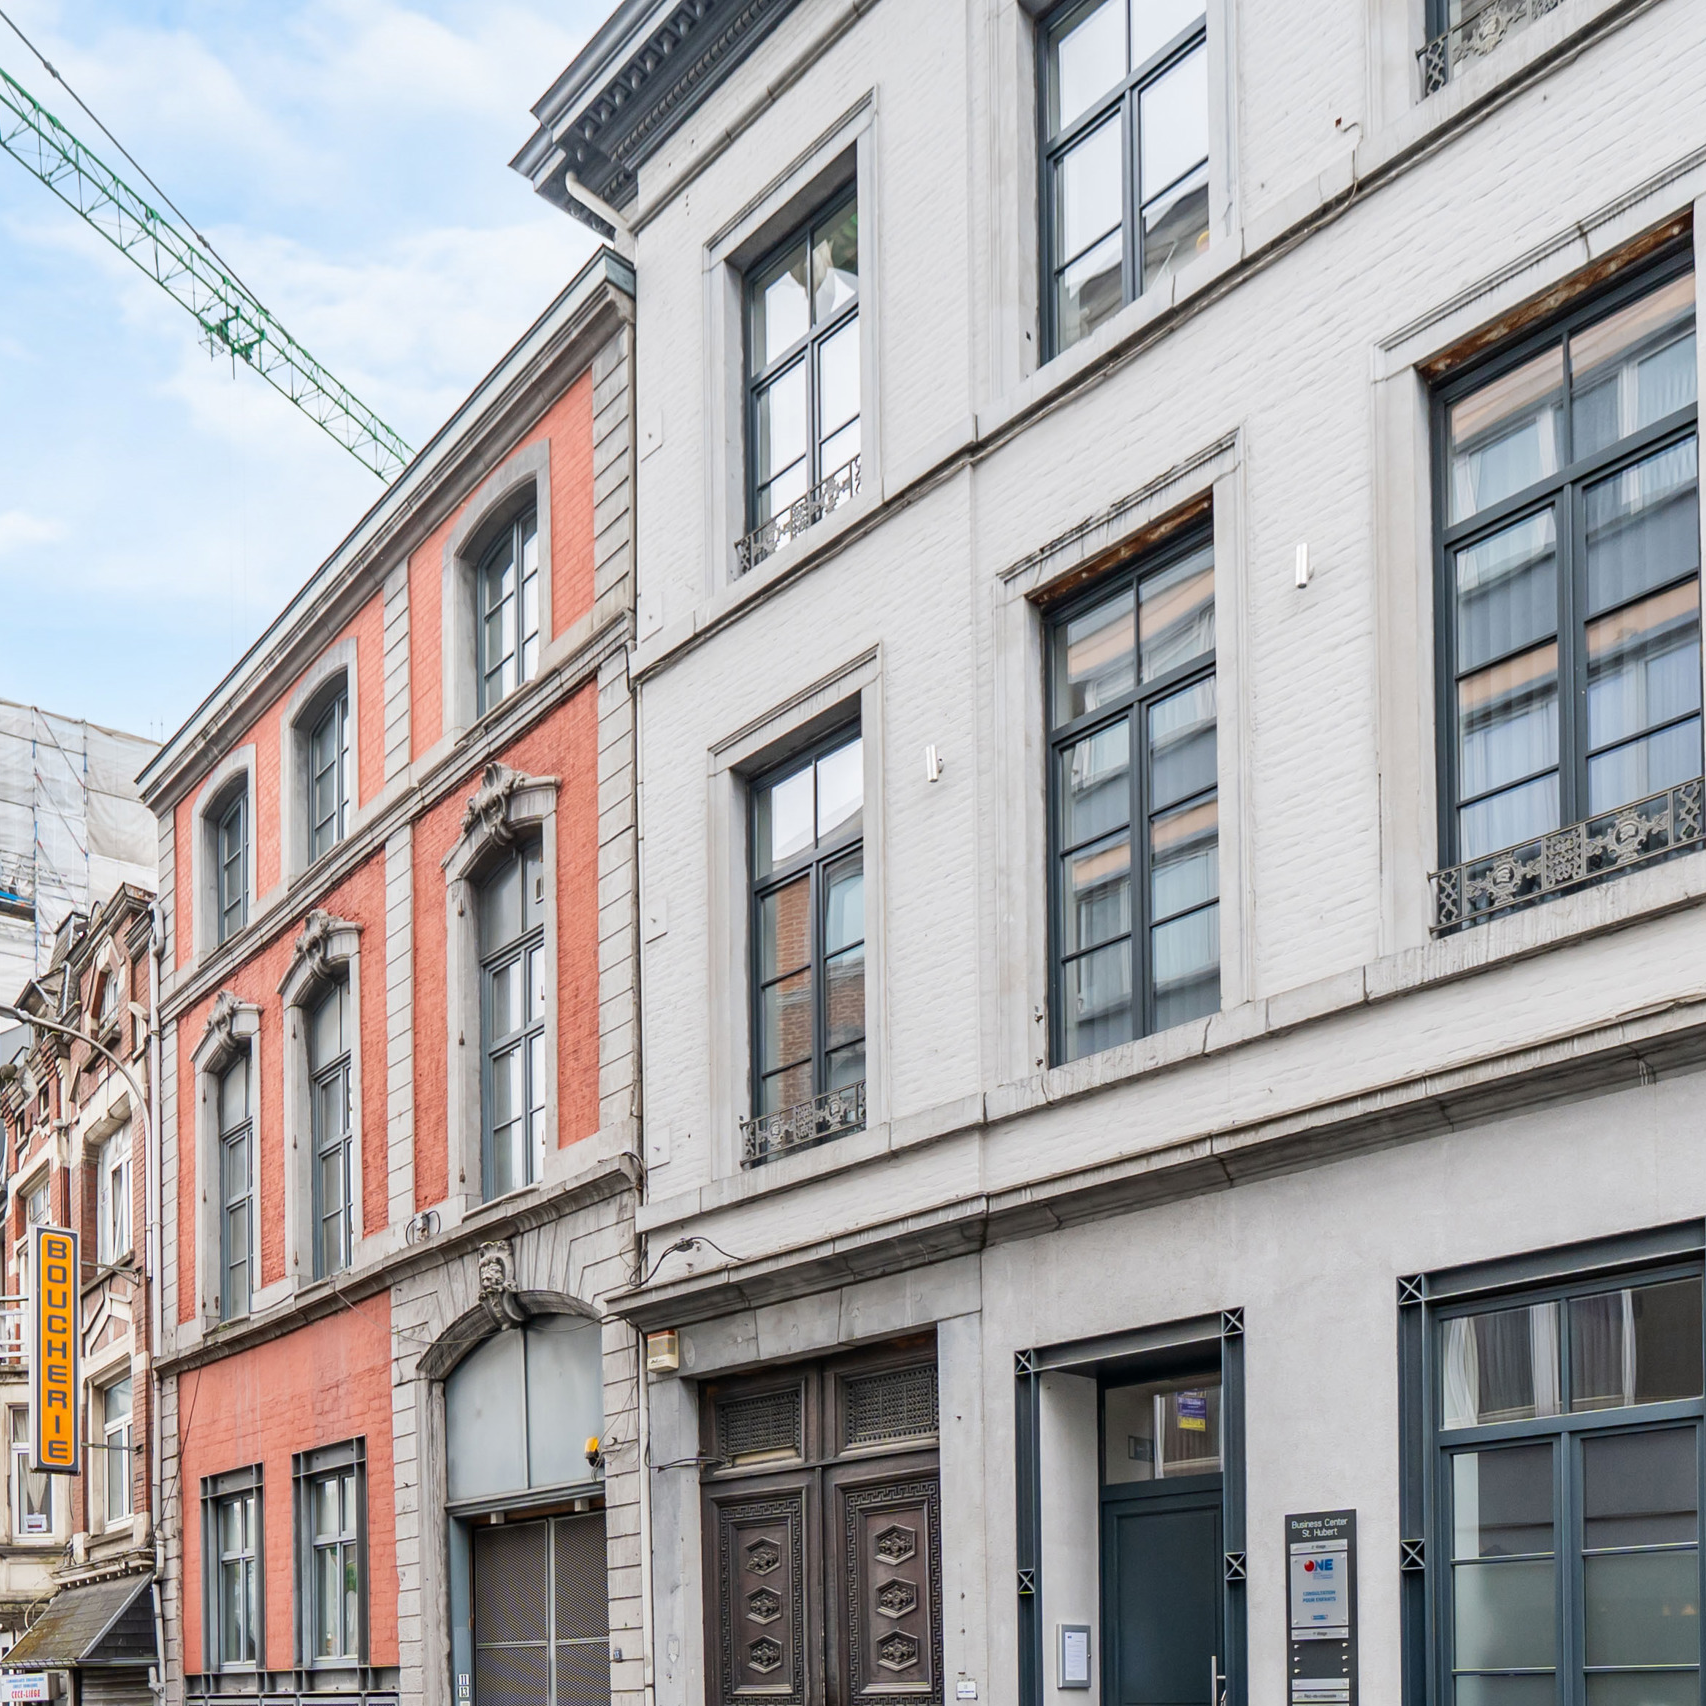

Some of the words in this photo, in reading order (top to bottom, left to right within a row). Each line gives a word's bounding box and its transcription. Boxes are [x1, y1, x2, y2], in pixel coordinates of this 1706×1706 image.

[46, 1238, 69, 1460] BOUCHERIE
[1291, 1520, 1322, 1530] Business
[1324, 1518, 1349, 1527] Center
[1313, 1527, 1339, 1537] Hubert
[460, 1674, 468, 1686] 11
